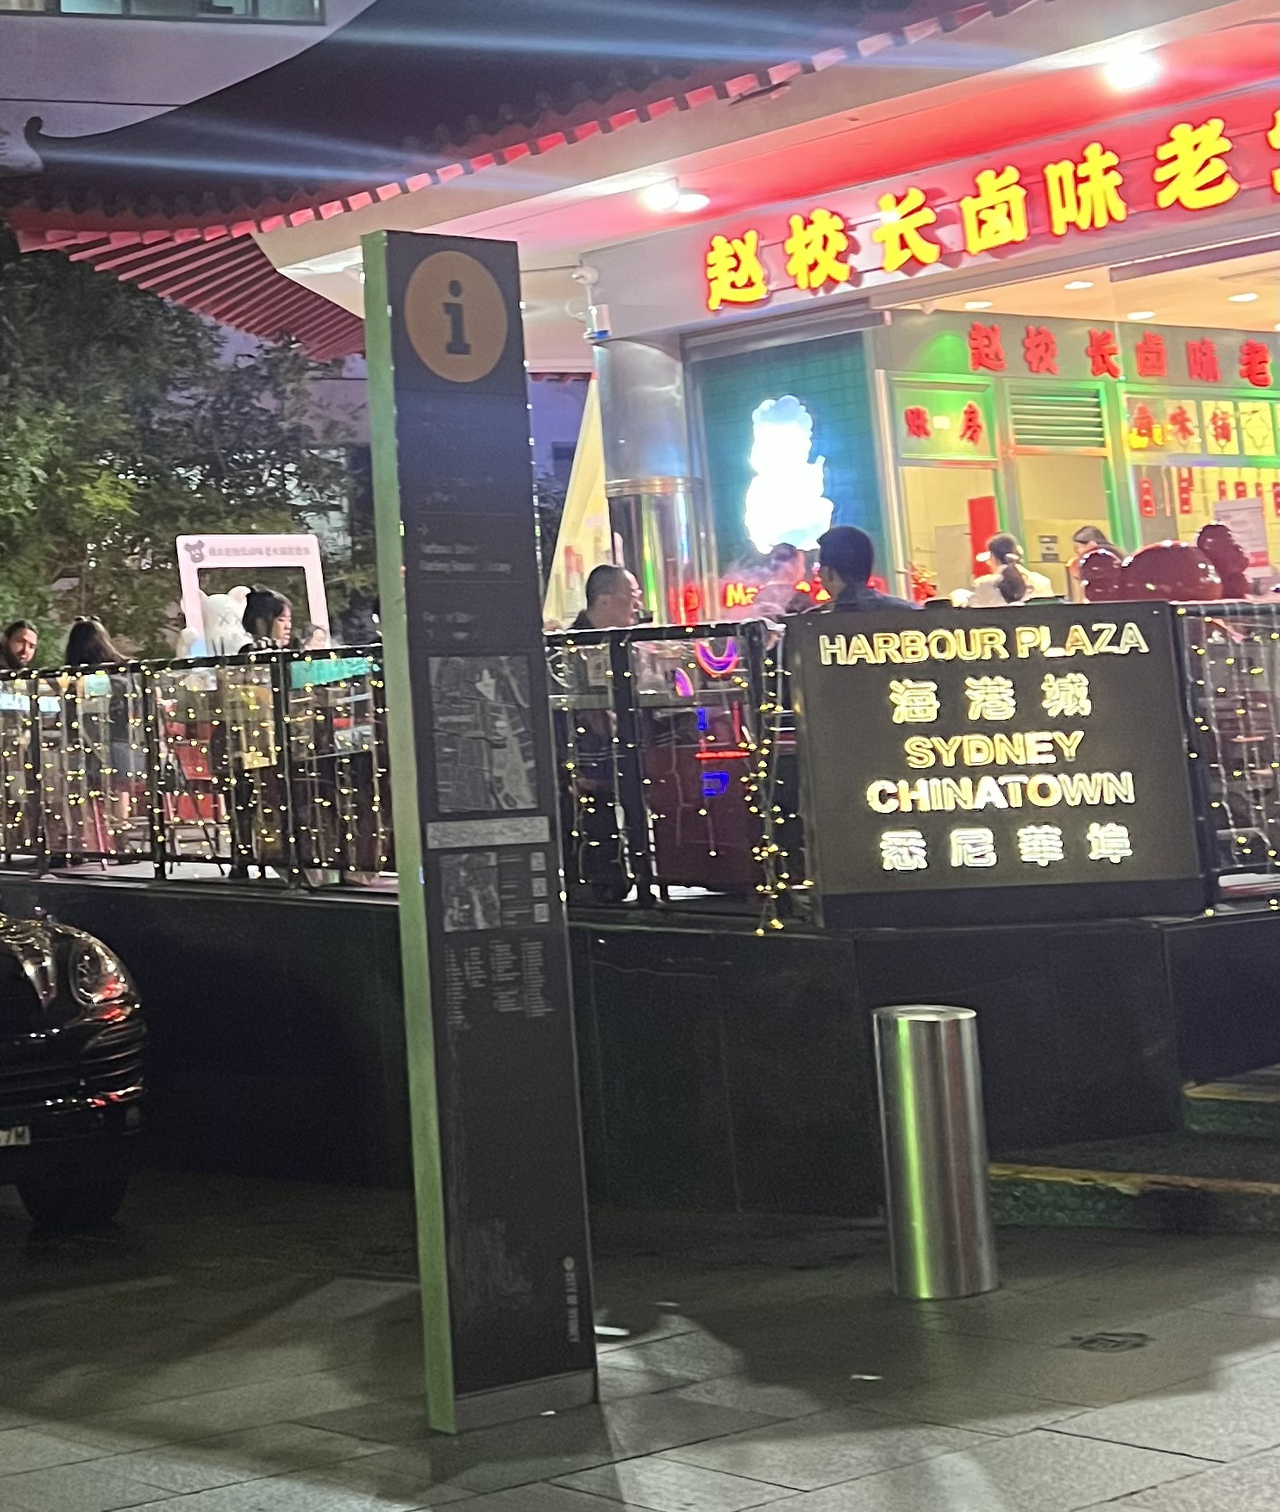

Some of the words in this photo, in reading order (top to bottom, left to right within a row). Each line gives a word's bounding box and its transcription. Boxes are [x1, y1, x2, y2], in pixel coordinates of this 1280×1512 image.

[704, 108, 1280, 311] 赵校长卤味老
[818, 627, 1010, 666] HARBOUR
[1016, 620, 1150, 660] PLAZA
[888, 672, 1093, 725] 海港城
[903, 730, 1086, 769] SYDNEY
[865, 771, 1137, 814] CHINATOWN
[879, 821, 1134, 872] 悉尼華埠
